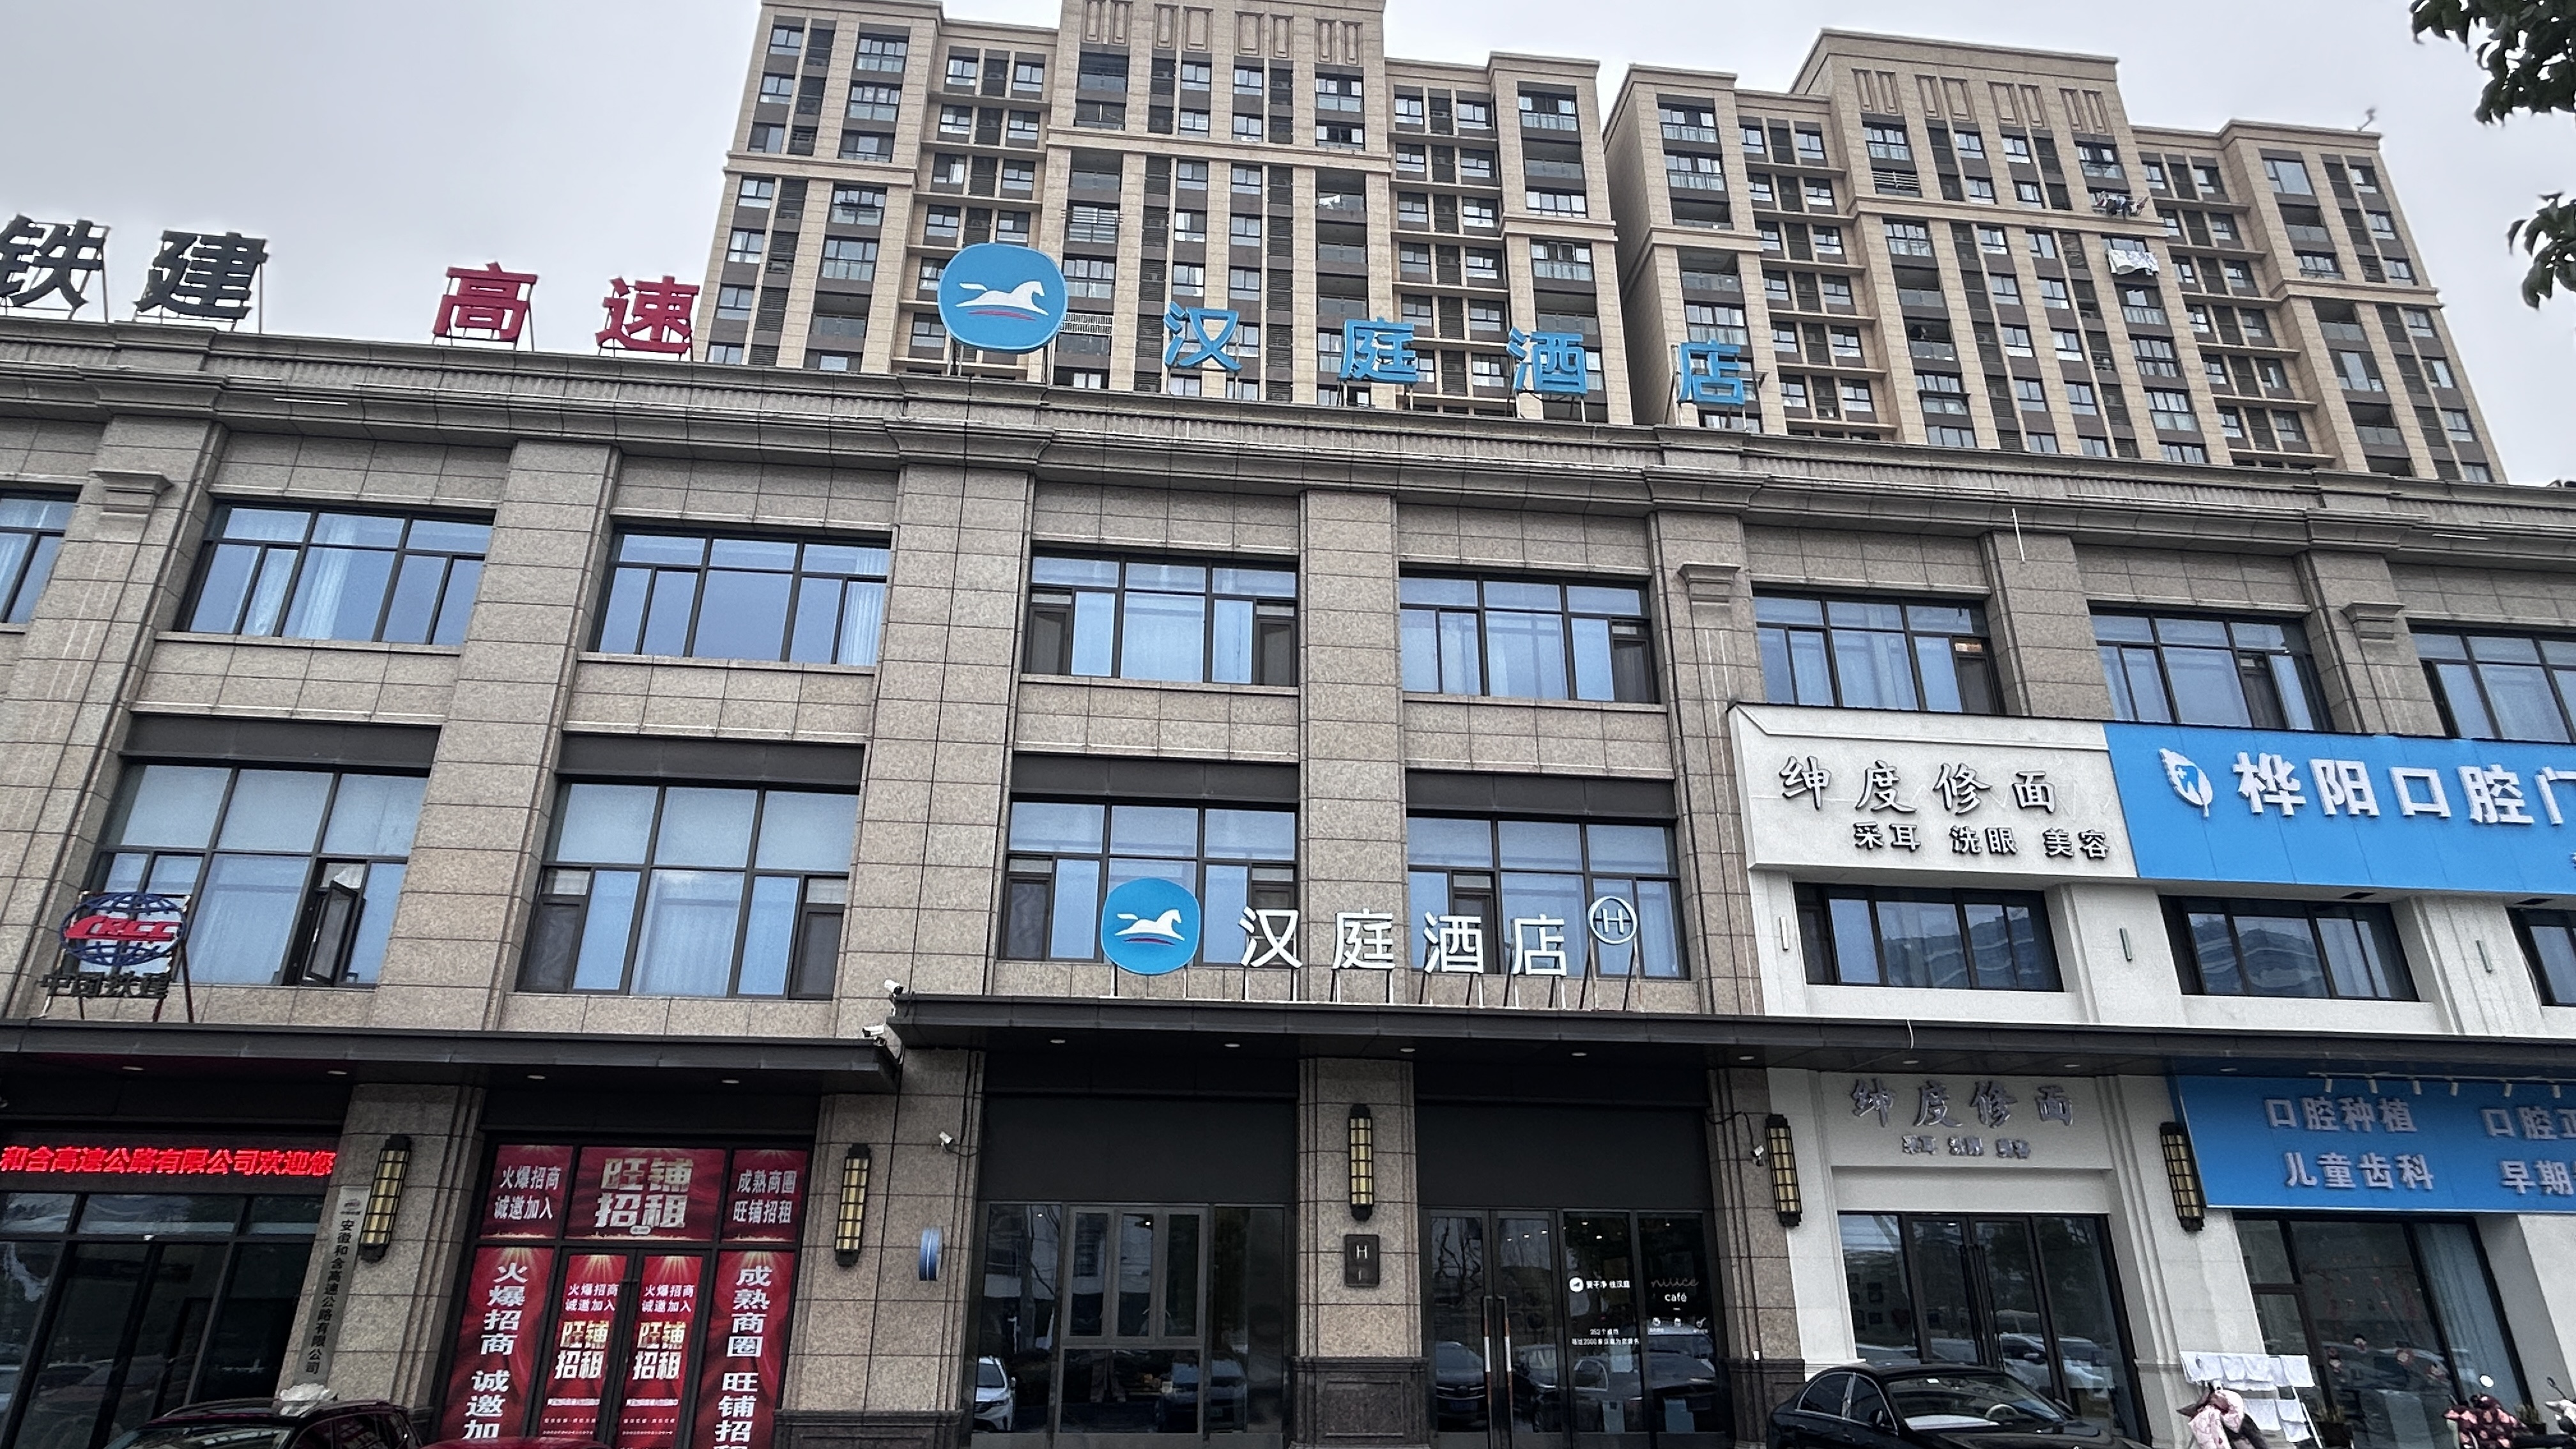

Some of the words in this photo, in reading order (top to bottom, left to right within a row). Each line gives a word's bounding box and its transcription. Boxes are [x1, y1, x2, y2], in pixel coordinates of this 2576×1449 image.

[0, 214, 268, 319] 铁建
[433, 262, 701, 353] 高速
[1163, 301, 1745, 406] 汉庭酒店
[1779, 756, 2057, 815] 绅度修面
[2232, 751, 2576, 825] 桦阳口腔门
[1853, 821, 1920, 852] 采耳
[1949, 826, 2018, 855] 洗眼
[2044, 829, 2110, 860] 美容
[1238, 906, 1568, 977] 汉庭酒店
[2264, 1096, 2417, 1132] 口腔种植
[499, 1165, 562, 1190] 火爆招商
[601, 1158, 694, 1192] 旺铺
[737, 1169, 797, 1194] 成熟商圈
[2283, 1153, 2434, 1190] 儿童齿科
[2500, 1160, 2576, 1195] 早期
[494, 1195, 553, 1220] 诚邀加入
[594, 1192, 688, 1228] 招租
[732, 1199, 792, 1224] 旺铺招租
[565, 1298, 615, 1312] 诚邀加入
[568, 1283, 619, 1297] 火爆招商
[641, 1300, 691, 1313] 诚邀加入
[644, 1284, 694, 1298] 火爆招商
[480, 1262, 528, 1355] 火爆招商
[726, 1265, 772, 1358] 成熟商圈
[560, 1320, 610, 1349] 旺铺
[637, 1321, 686, 1350] 旺铺
[554, 1349, 604, 1379] 招租
[632, 1351, 682, 1381] 招租
[713, 1372, 759, 1449] 旺铺招
